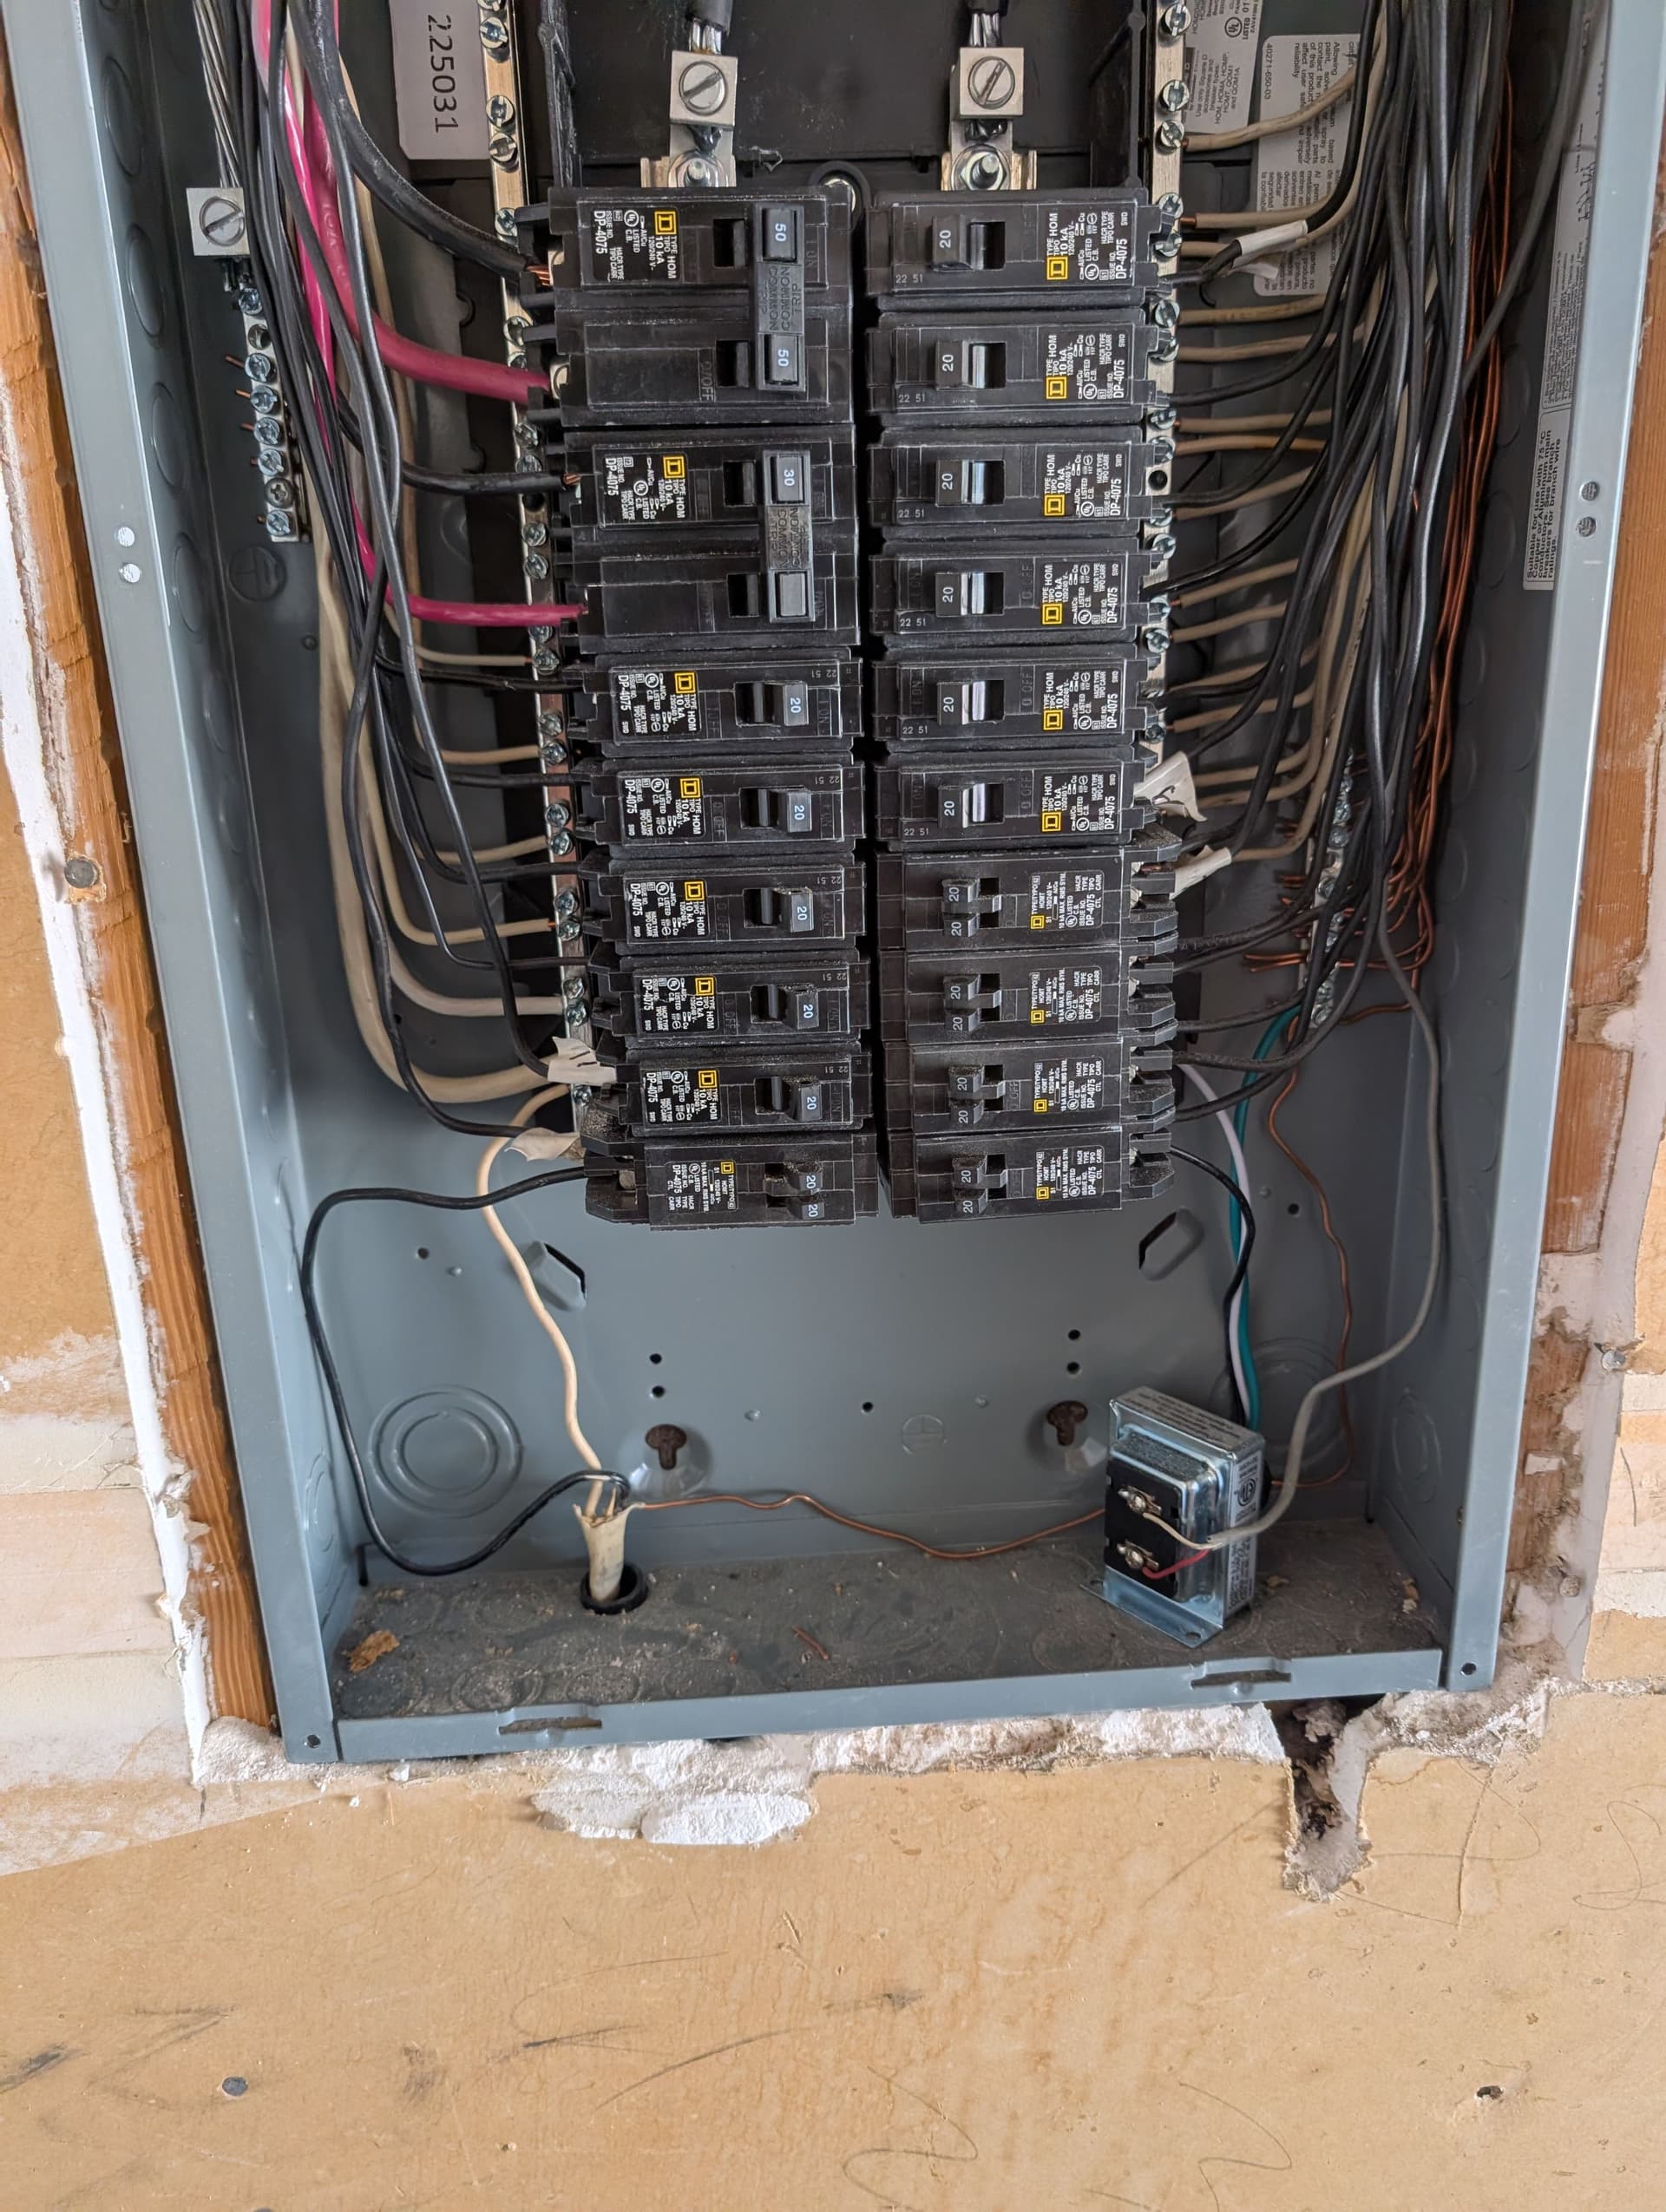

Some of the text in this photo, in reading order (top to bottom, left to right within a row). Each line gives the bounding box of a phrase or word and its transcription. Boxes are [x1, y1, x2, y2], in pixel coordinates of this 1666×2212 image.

[428, 14, 459, 133] 225031
[594, 210, 607, 254] DP-4075
[775, 223, 786, 242] 50
[1049, 213, 1058, 236] HOM
[940, 230, 951, 248] 20
[667, 255, 676, 279] HOM
[1116, 239, 1127, 279] DP-4075
[1048, 334, 1057, 357] HOM
[777, 349, 789, 367] 50
[942, 354, 954, 371] 20
[1113, 359, 1125, 399] DP-4075
[1046, 454, 1055, 476] HOM
[606, 458, 619, 495] DP-4075
[784, 469, 795, 486] 30
[941, 473, 953, 490] 20
[1111, 478, 1121, 516] DP-4075
[676, 496, 685, 519] HOM
[1044, 564, 1053, 586] HOM
[942, 586, 954, 603] 20
[1107, 586, 1118, 624] DP-4075
[1046, 672, 1054, 693] HOM
[619, 675, 632, 711] DP-4075
[790, 697, 801, 714] 20
[943, 697, 954, 712] 20
[1106, 693, 1118, 730] DP-4075
[687, 710, 697, 731] HOM
[1044, 776, 1053, 796] HOM
[625, 779, 638, 815] DP-4075
[794, 805, 804, 820] 20
[944, 801, 954, 816] 20
[1104, 795, 1115, 830] DP-4075
[692, 815, 701, 834] HOM
[630, 883, 643, 916] DP-4075
[949, 887, 959, 901] 20
[797, 905, 808, 920] 20
[1086, 893, 1095, 926] DP-4075
[696, 916, 705, 936] HOM
[951, 921, 961, 937] 20
[642, 979, 654, 1011] DP-4075
[951, 986, 961, 1000] 20
[803, 1004, 813, 1018] 20
[1085, 989, 1093, 1020] DP-4075
[706, 1011, 715, 1030] HOM
[953, 1017, 962, 1031] 20
[646, 1071, 659, 1103] DP-4075
[957, 1077, 967, 1091] 20
[709, 1103, 718, 1120] HOM
[807, 1096, 817, 1110] 20
[959, 1110, 968, 1124] 20
[672, 1164, 683, 1194] DP-4075
[806, 1175, 816, 1189] 20
[961, 1170, 971, 1183] 20
[1088, 1166, 1097, 1195] DP-4075
[808, 1204, 818, 1218] 20
[963, 1201, 973, 1214] 20
